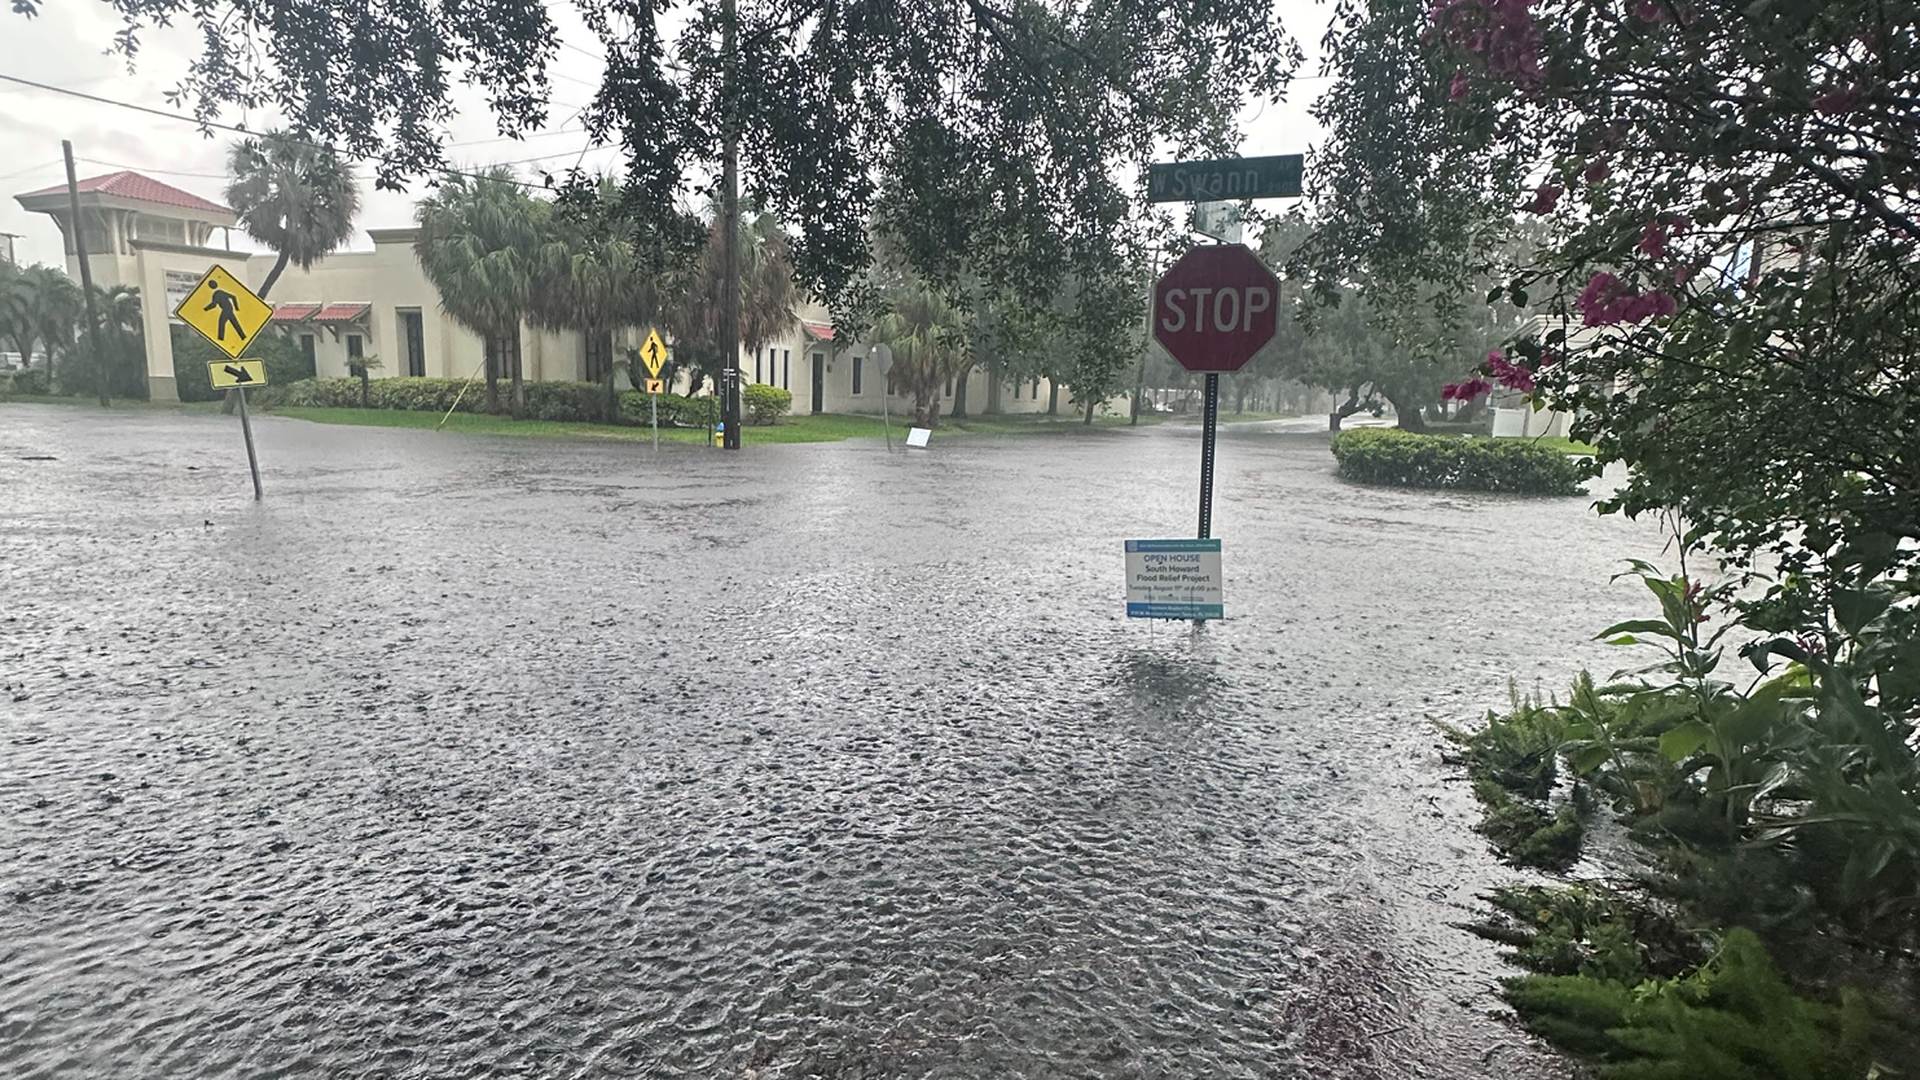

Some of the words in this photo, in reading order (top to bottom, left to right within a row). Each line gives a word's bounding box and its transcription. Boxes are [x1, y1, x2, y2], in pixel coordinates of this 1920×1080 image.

[1153, 172, 1167, 194] W
[1171, 168, 1259, 197] Swann
[1162, 287, 1270, 332] STOP
[1144, 554, 1167, 562] OPEN
[1169, 554, 1201, 562] HOUSE
[1145, 565, 1167, 573] South
[1169, 565, 1200, 573] Howard
[1136, 574, 1157, 582] Flood
[1159, 574, 1180, 582] Relief
[1182, 574, 1210, 583] Project
